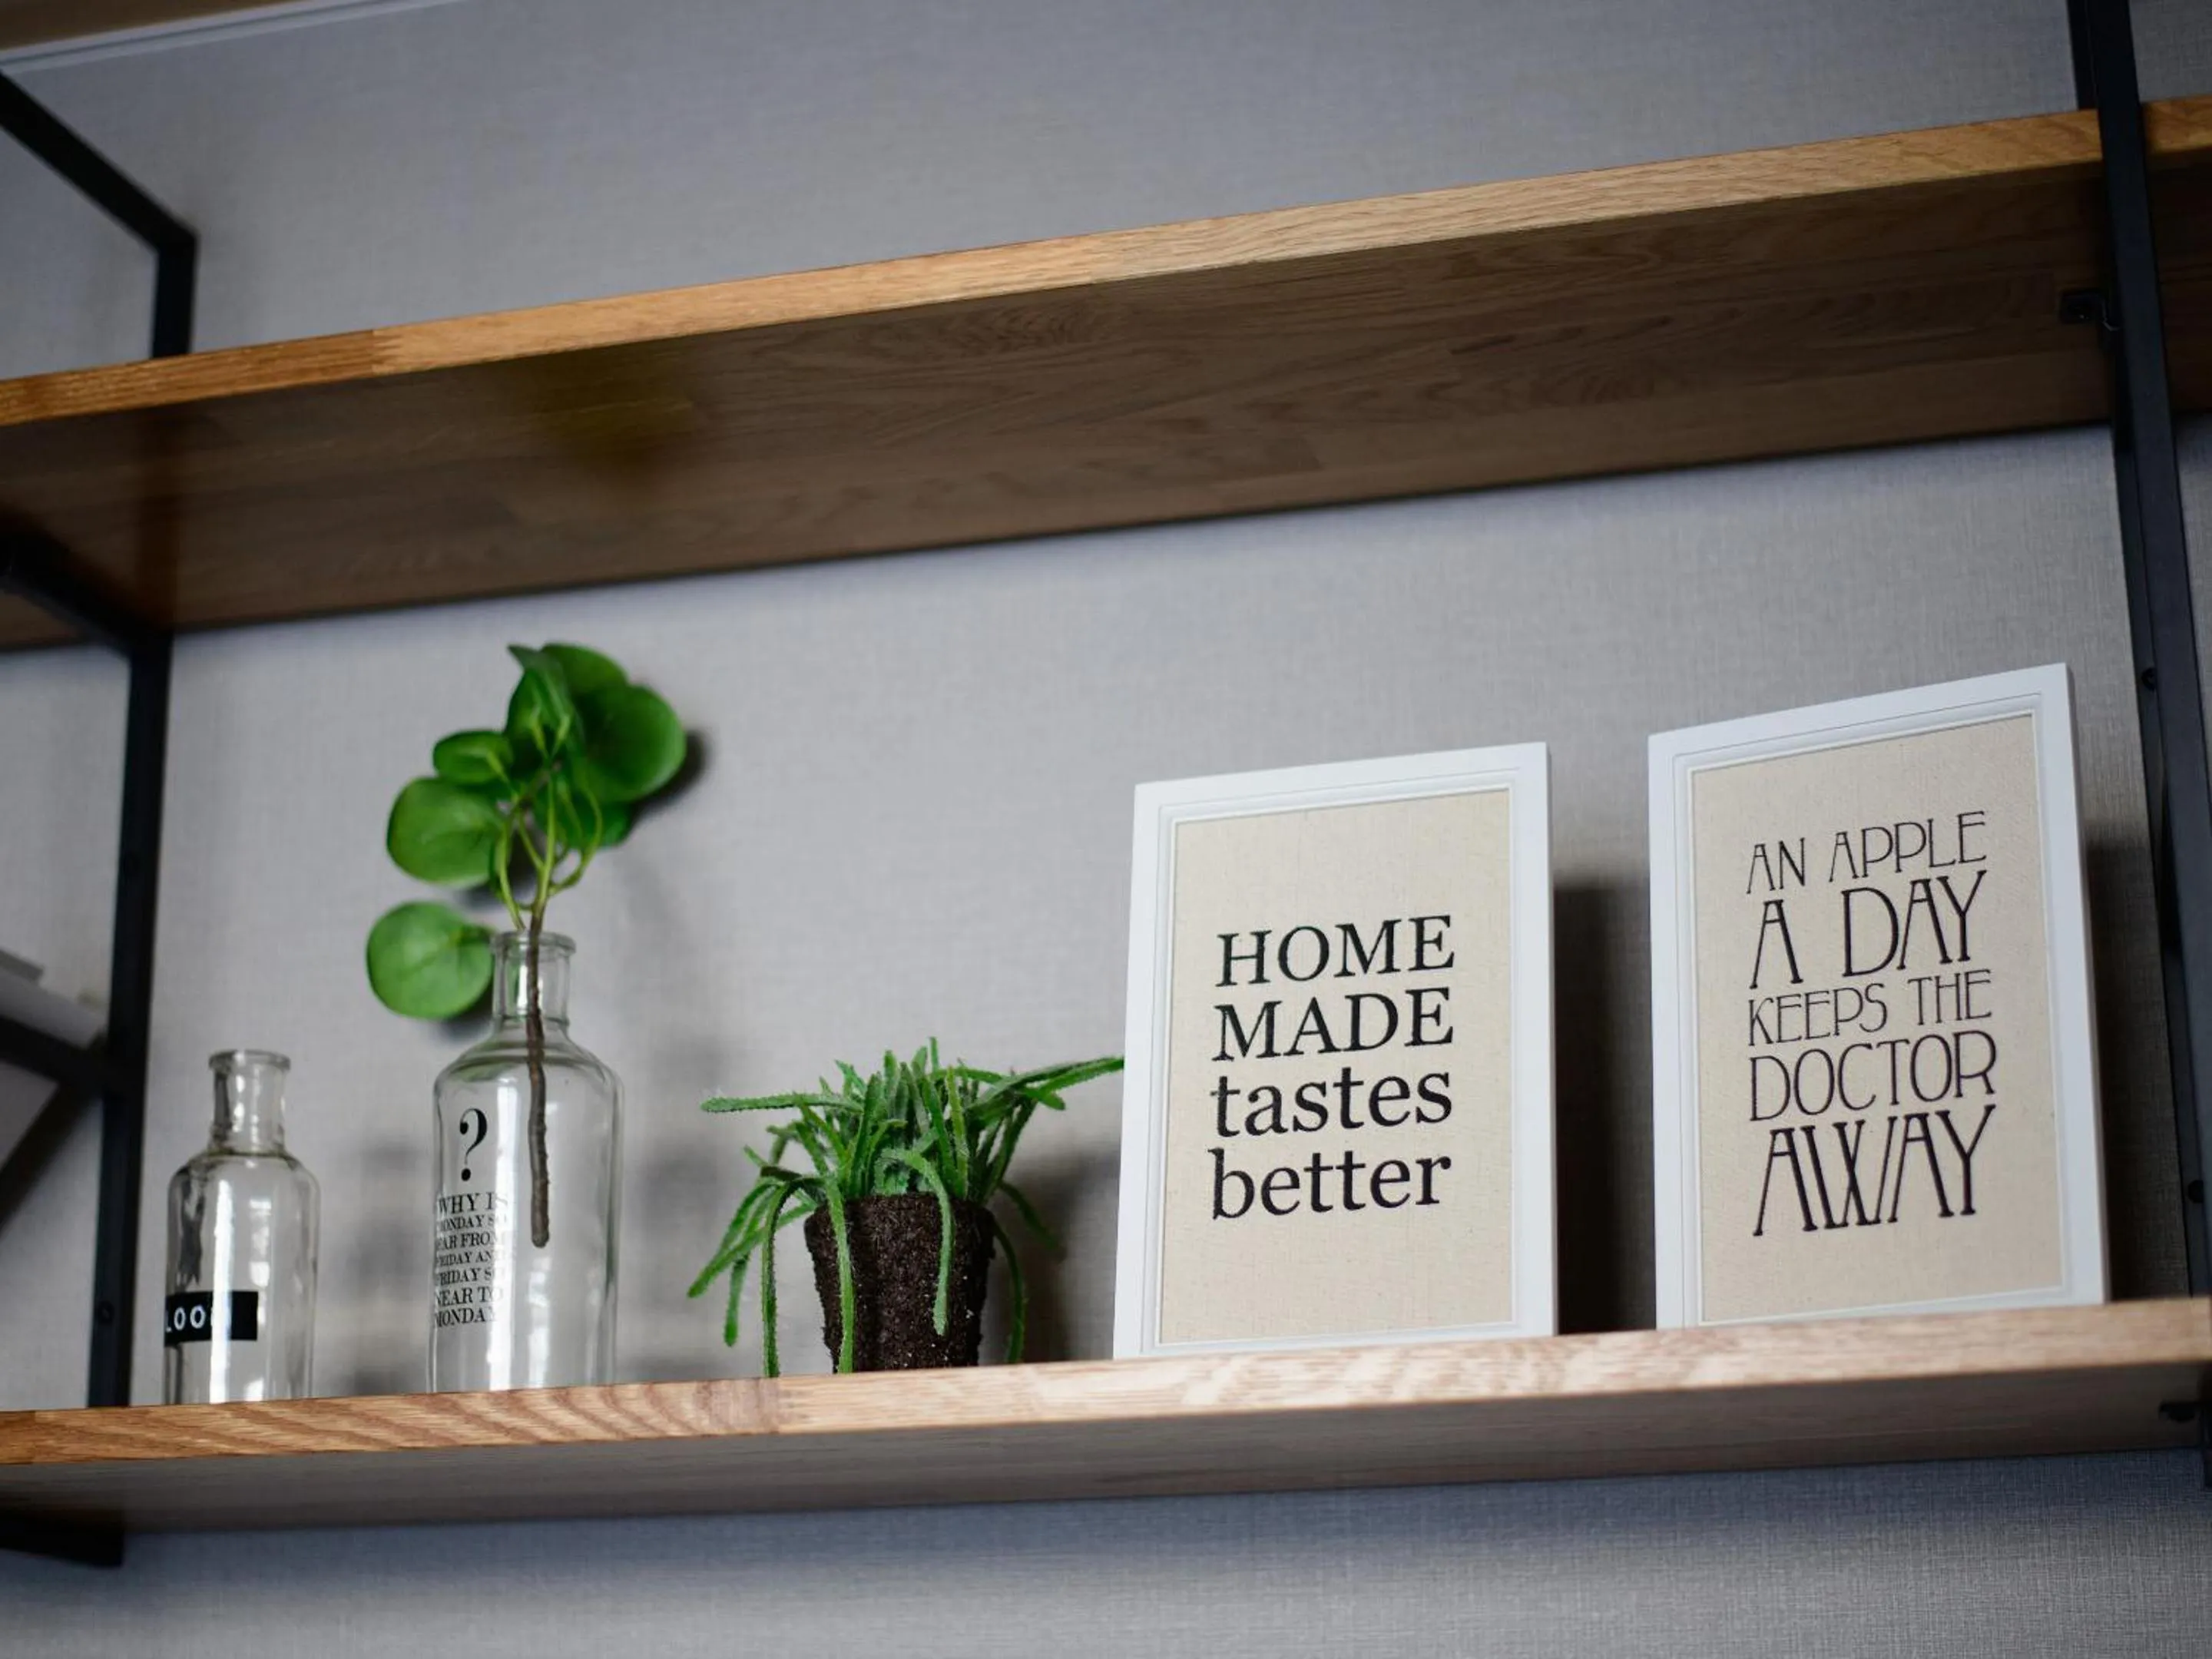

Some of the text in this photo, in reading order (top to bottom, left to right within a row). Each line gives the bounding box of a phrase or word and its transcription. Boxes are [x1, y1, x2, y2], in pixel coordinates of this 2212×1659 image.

[1747, 810, 1987, 894] AN APPLE
[1215, 915, 1455, 987] HOME
[1750, 869, 1987, 989] A DAY
[1211, 987, 1454, 1061] MADE
[1748, 969, 1992, 1046] KEEPS THE
[1210, 1066, 1452, 1137] tastes
[1749, 1030, 1997, 1122] DOCTOR
[459, 1108, 488, 1181] ?
[1753, 1104, 1997, 1237] AWAY
[438, 1192, 480, 1214] WHY
[1207, 1147, 1452, 1220] better
[437, 1214, 484, 1232] ONDAY
[475, 1249, 505, 1263] AN
